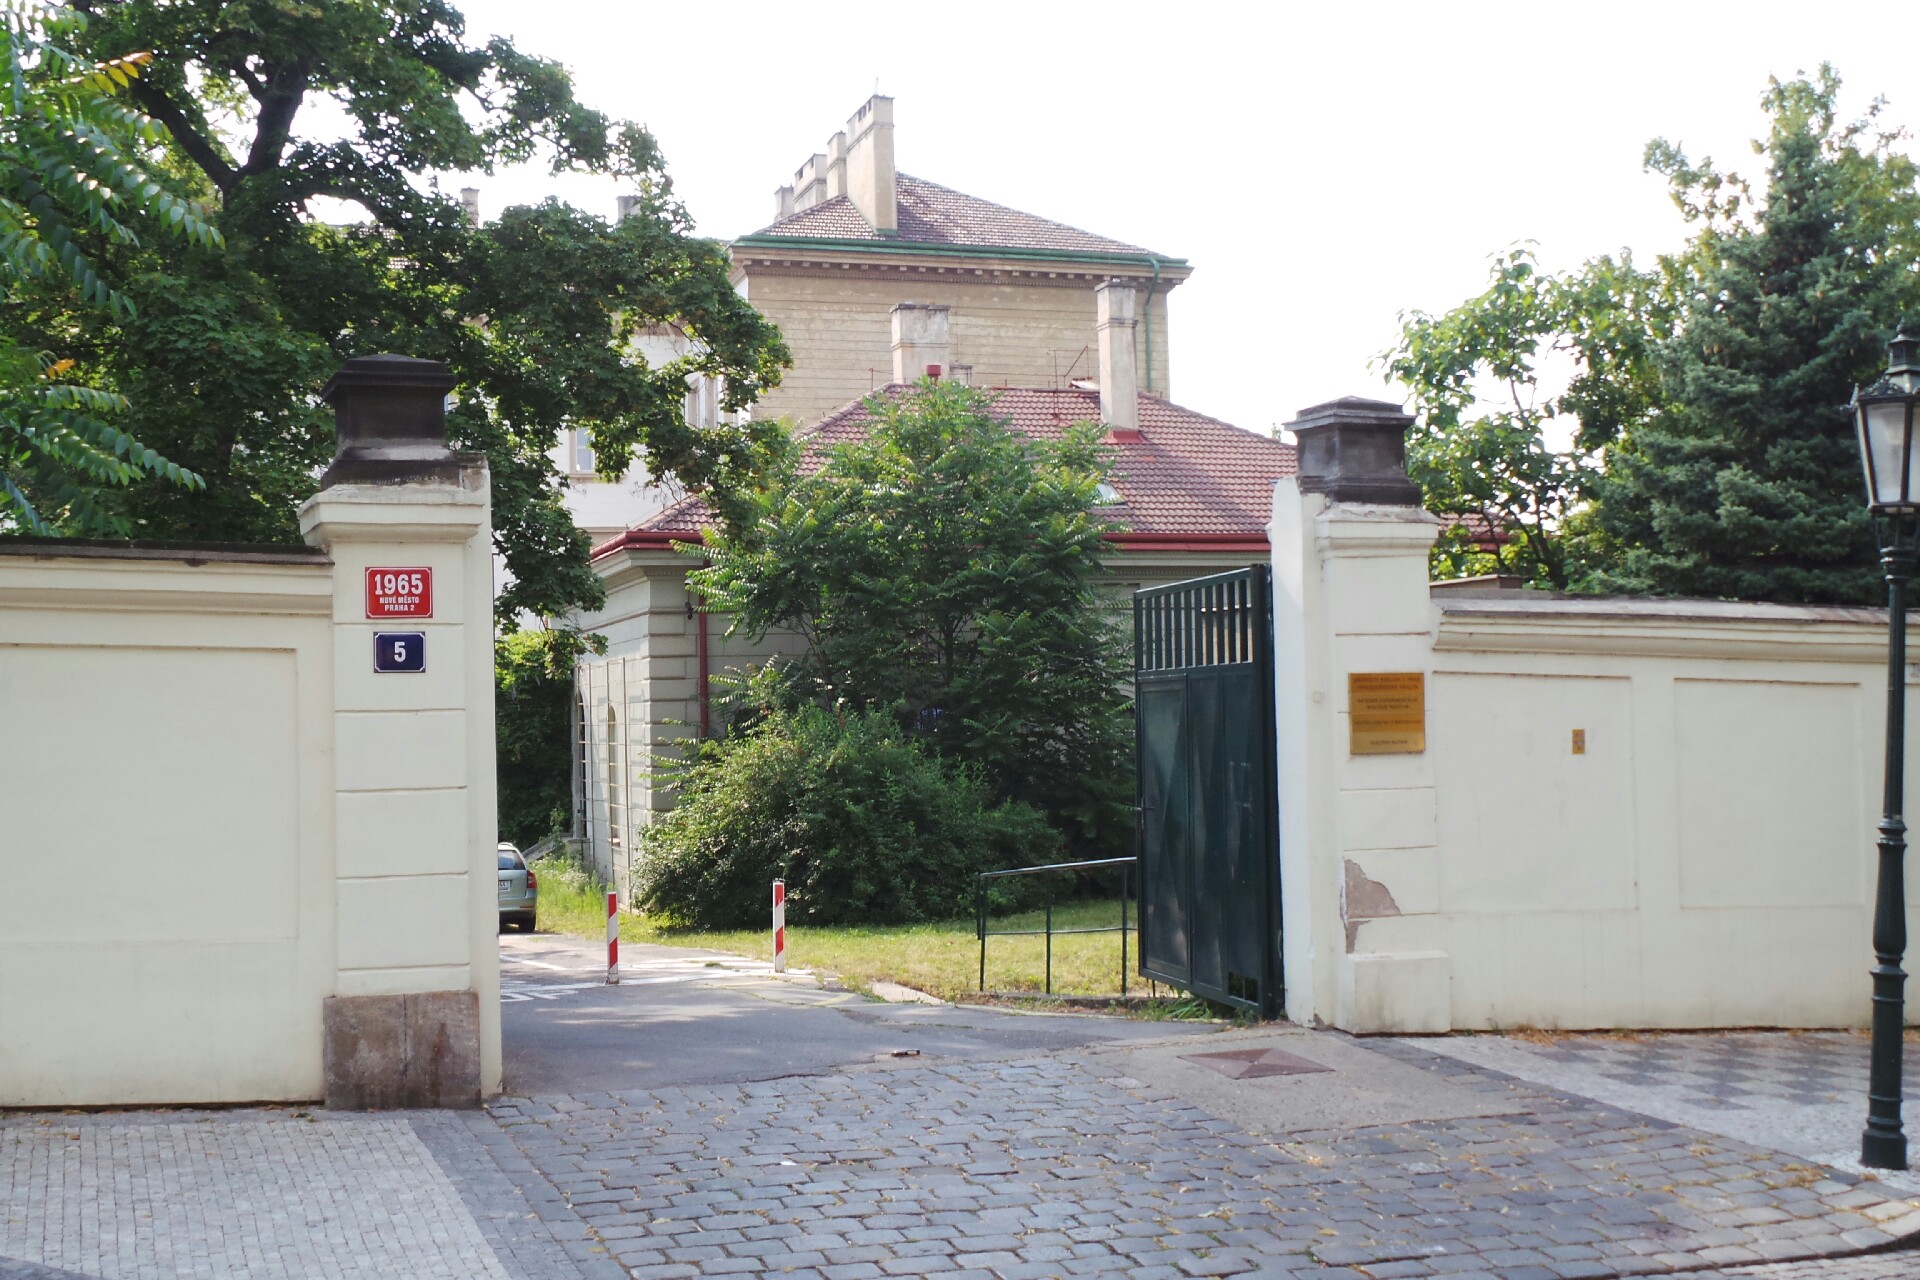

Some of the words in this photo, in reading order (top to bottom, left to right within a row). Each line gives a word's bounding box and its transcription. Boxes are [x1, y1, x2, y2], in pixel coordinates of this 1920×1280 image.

[374, 574, 423, 595] 1965
[379, 595, 397, 604] NOVÉ
[397, 595, 419, 604] MĚSTO
[384, 604, 409, 612] PRAHA
[394, 641, 406, 662] 5
